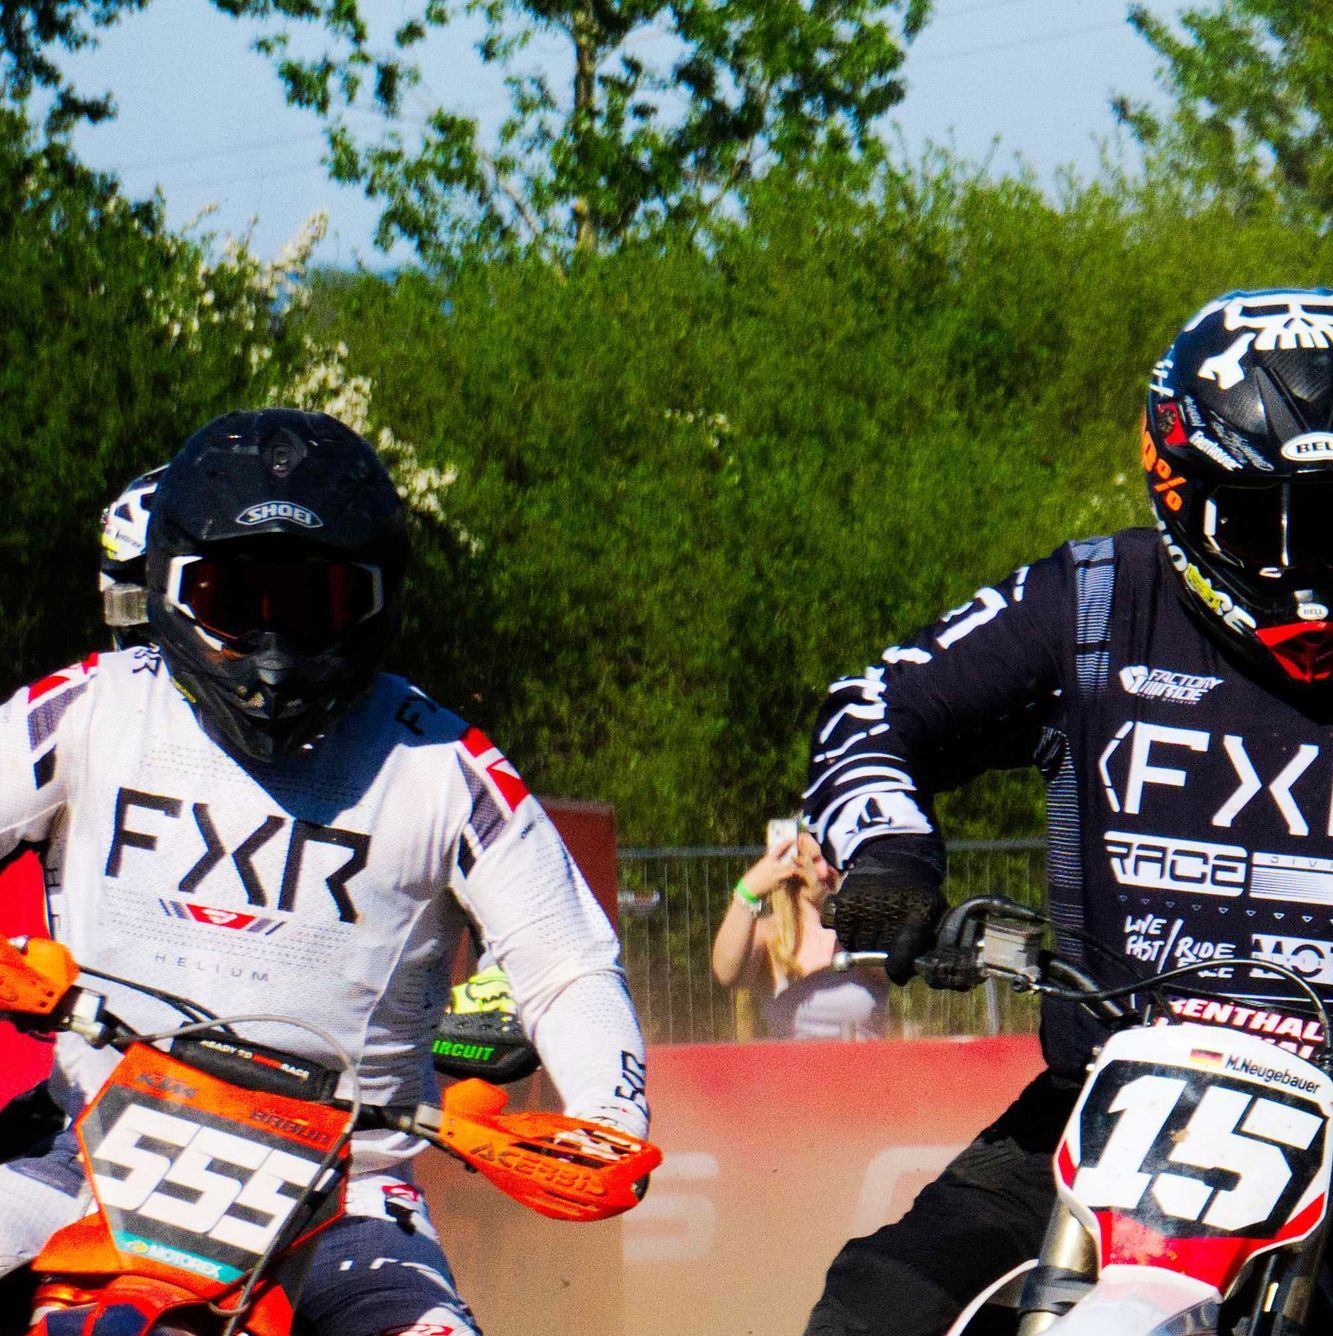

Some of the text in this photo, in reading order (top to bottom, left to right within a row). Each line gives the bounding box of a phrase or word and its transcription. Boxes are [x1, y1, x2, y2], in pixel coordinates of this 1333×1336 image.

[248, 503, 312, 525] SHOEI
[1303, 607, 1323, 616] BELL
[105, 786, 371, 924] FXR
[153, 953, 270, 983] HELIUM
[432, 1039, 494, 1062] IRCUIT
[1226, 1055, 1321, 1094] M.Neugebauer
[470, 1145, 608, 1196] ACERBIS
[1073, 1075, 1324, 1231] 15
[90, 1103, 322, 1256] 555
